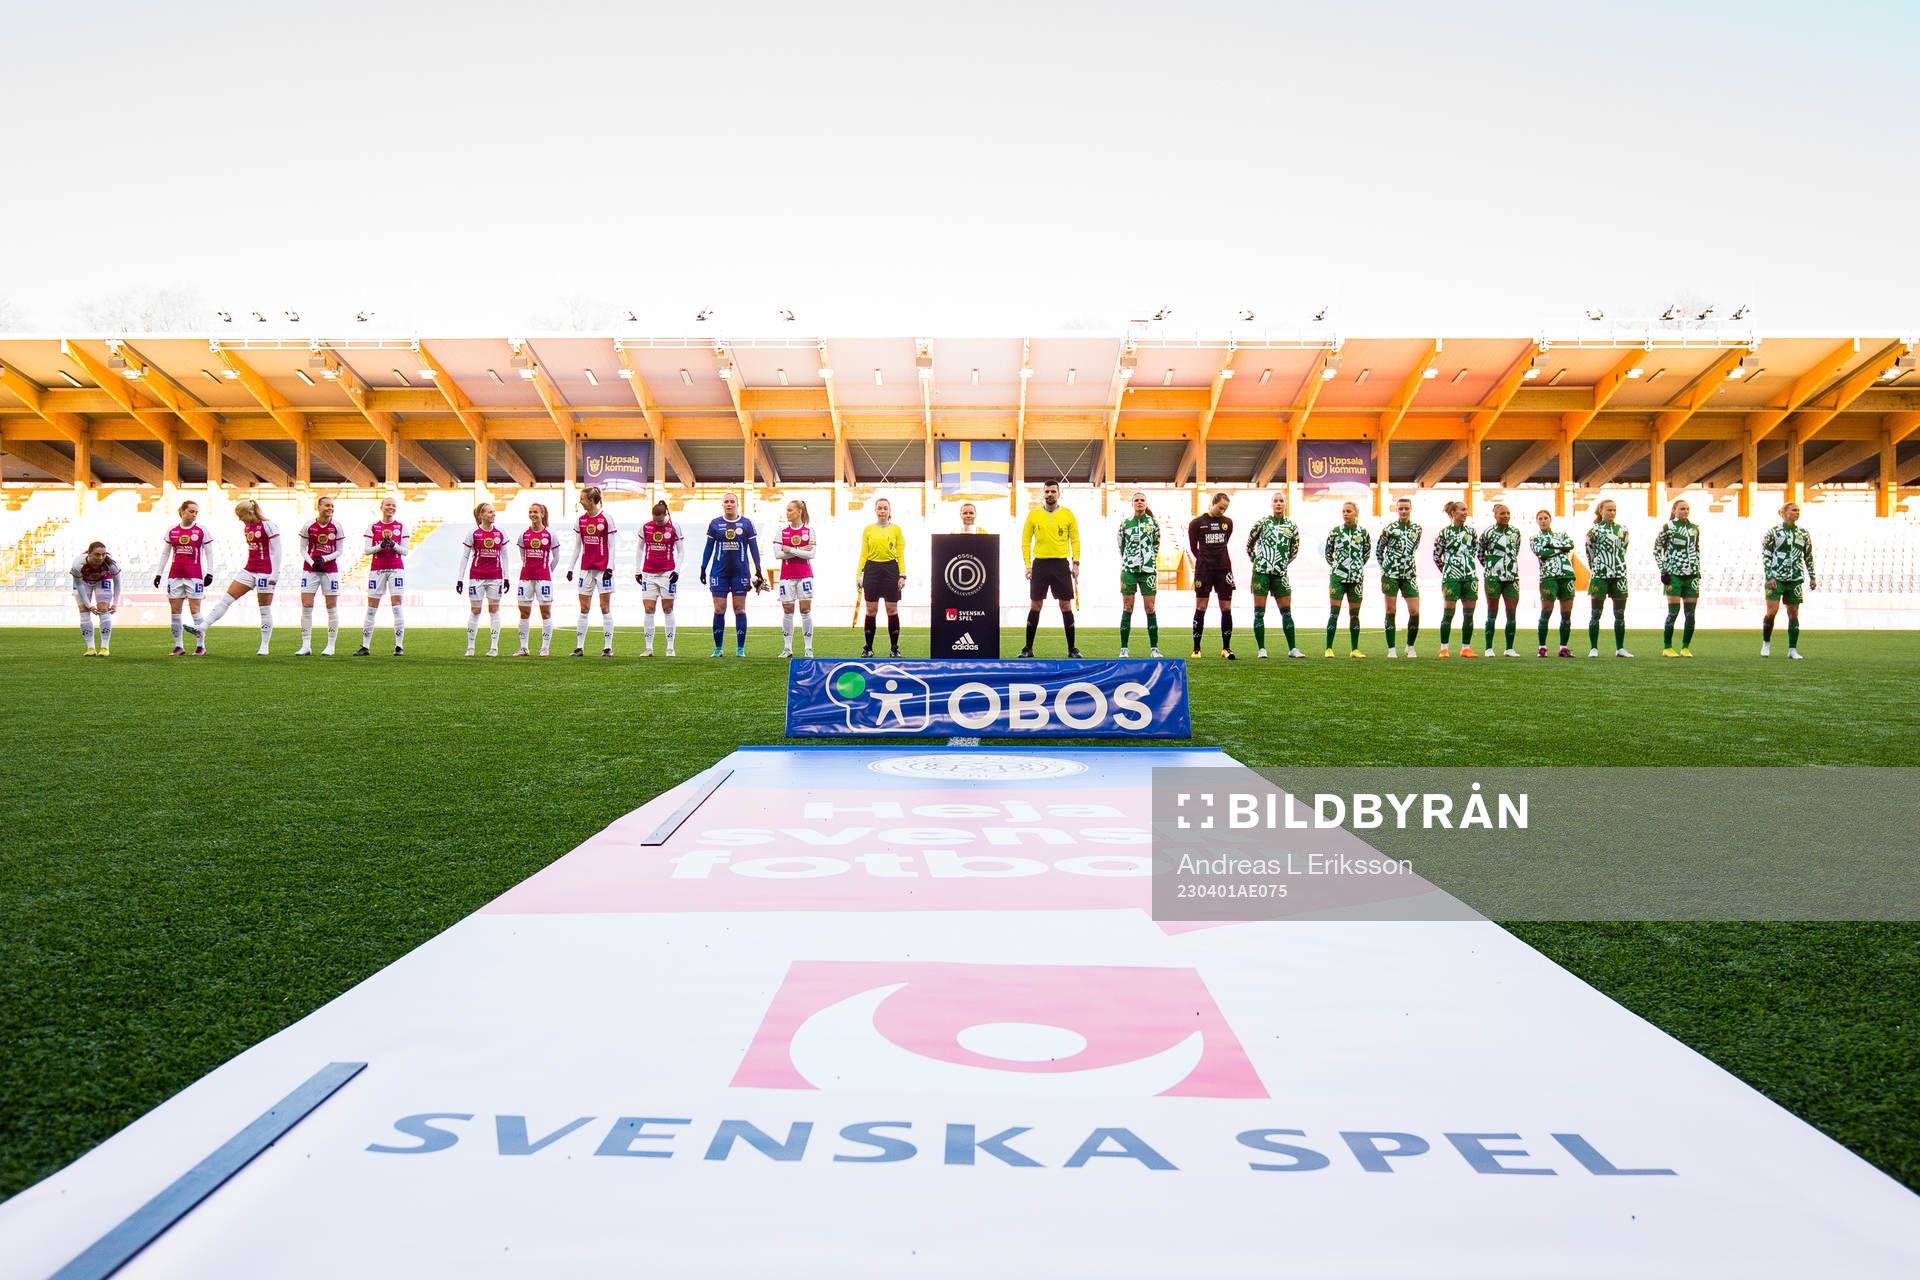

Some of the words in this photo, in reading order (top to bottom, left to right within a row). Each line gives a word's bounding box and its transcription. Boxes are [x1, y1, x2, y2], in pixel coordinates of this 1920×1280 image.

[605, 455, 640, 465] Uppsala
[1329, 457, 1363, 467] Uppsala
[605, 463, 643, 473] kommun
[1329, 465, 1367, 475] kommun
[959, 565, 975, 585] D
[951, 643, 979, 651] adidas
[948, 681, 1153, 731] OBOS
[803, 801, 1128, 823] Heja
[365, 1112, 1180, 1171] SVENSKA
[1236, 1128, 1679, 1177] SPEL
